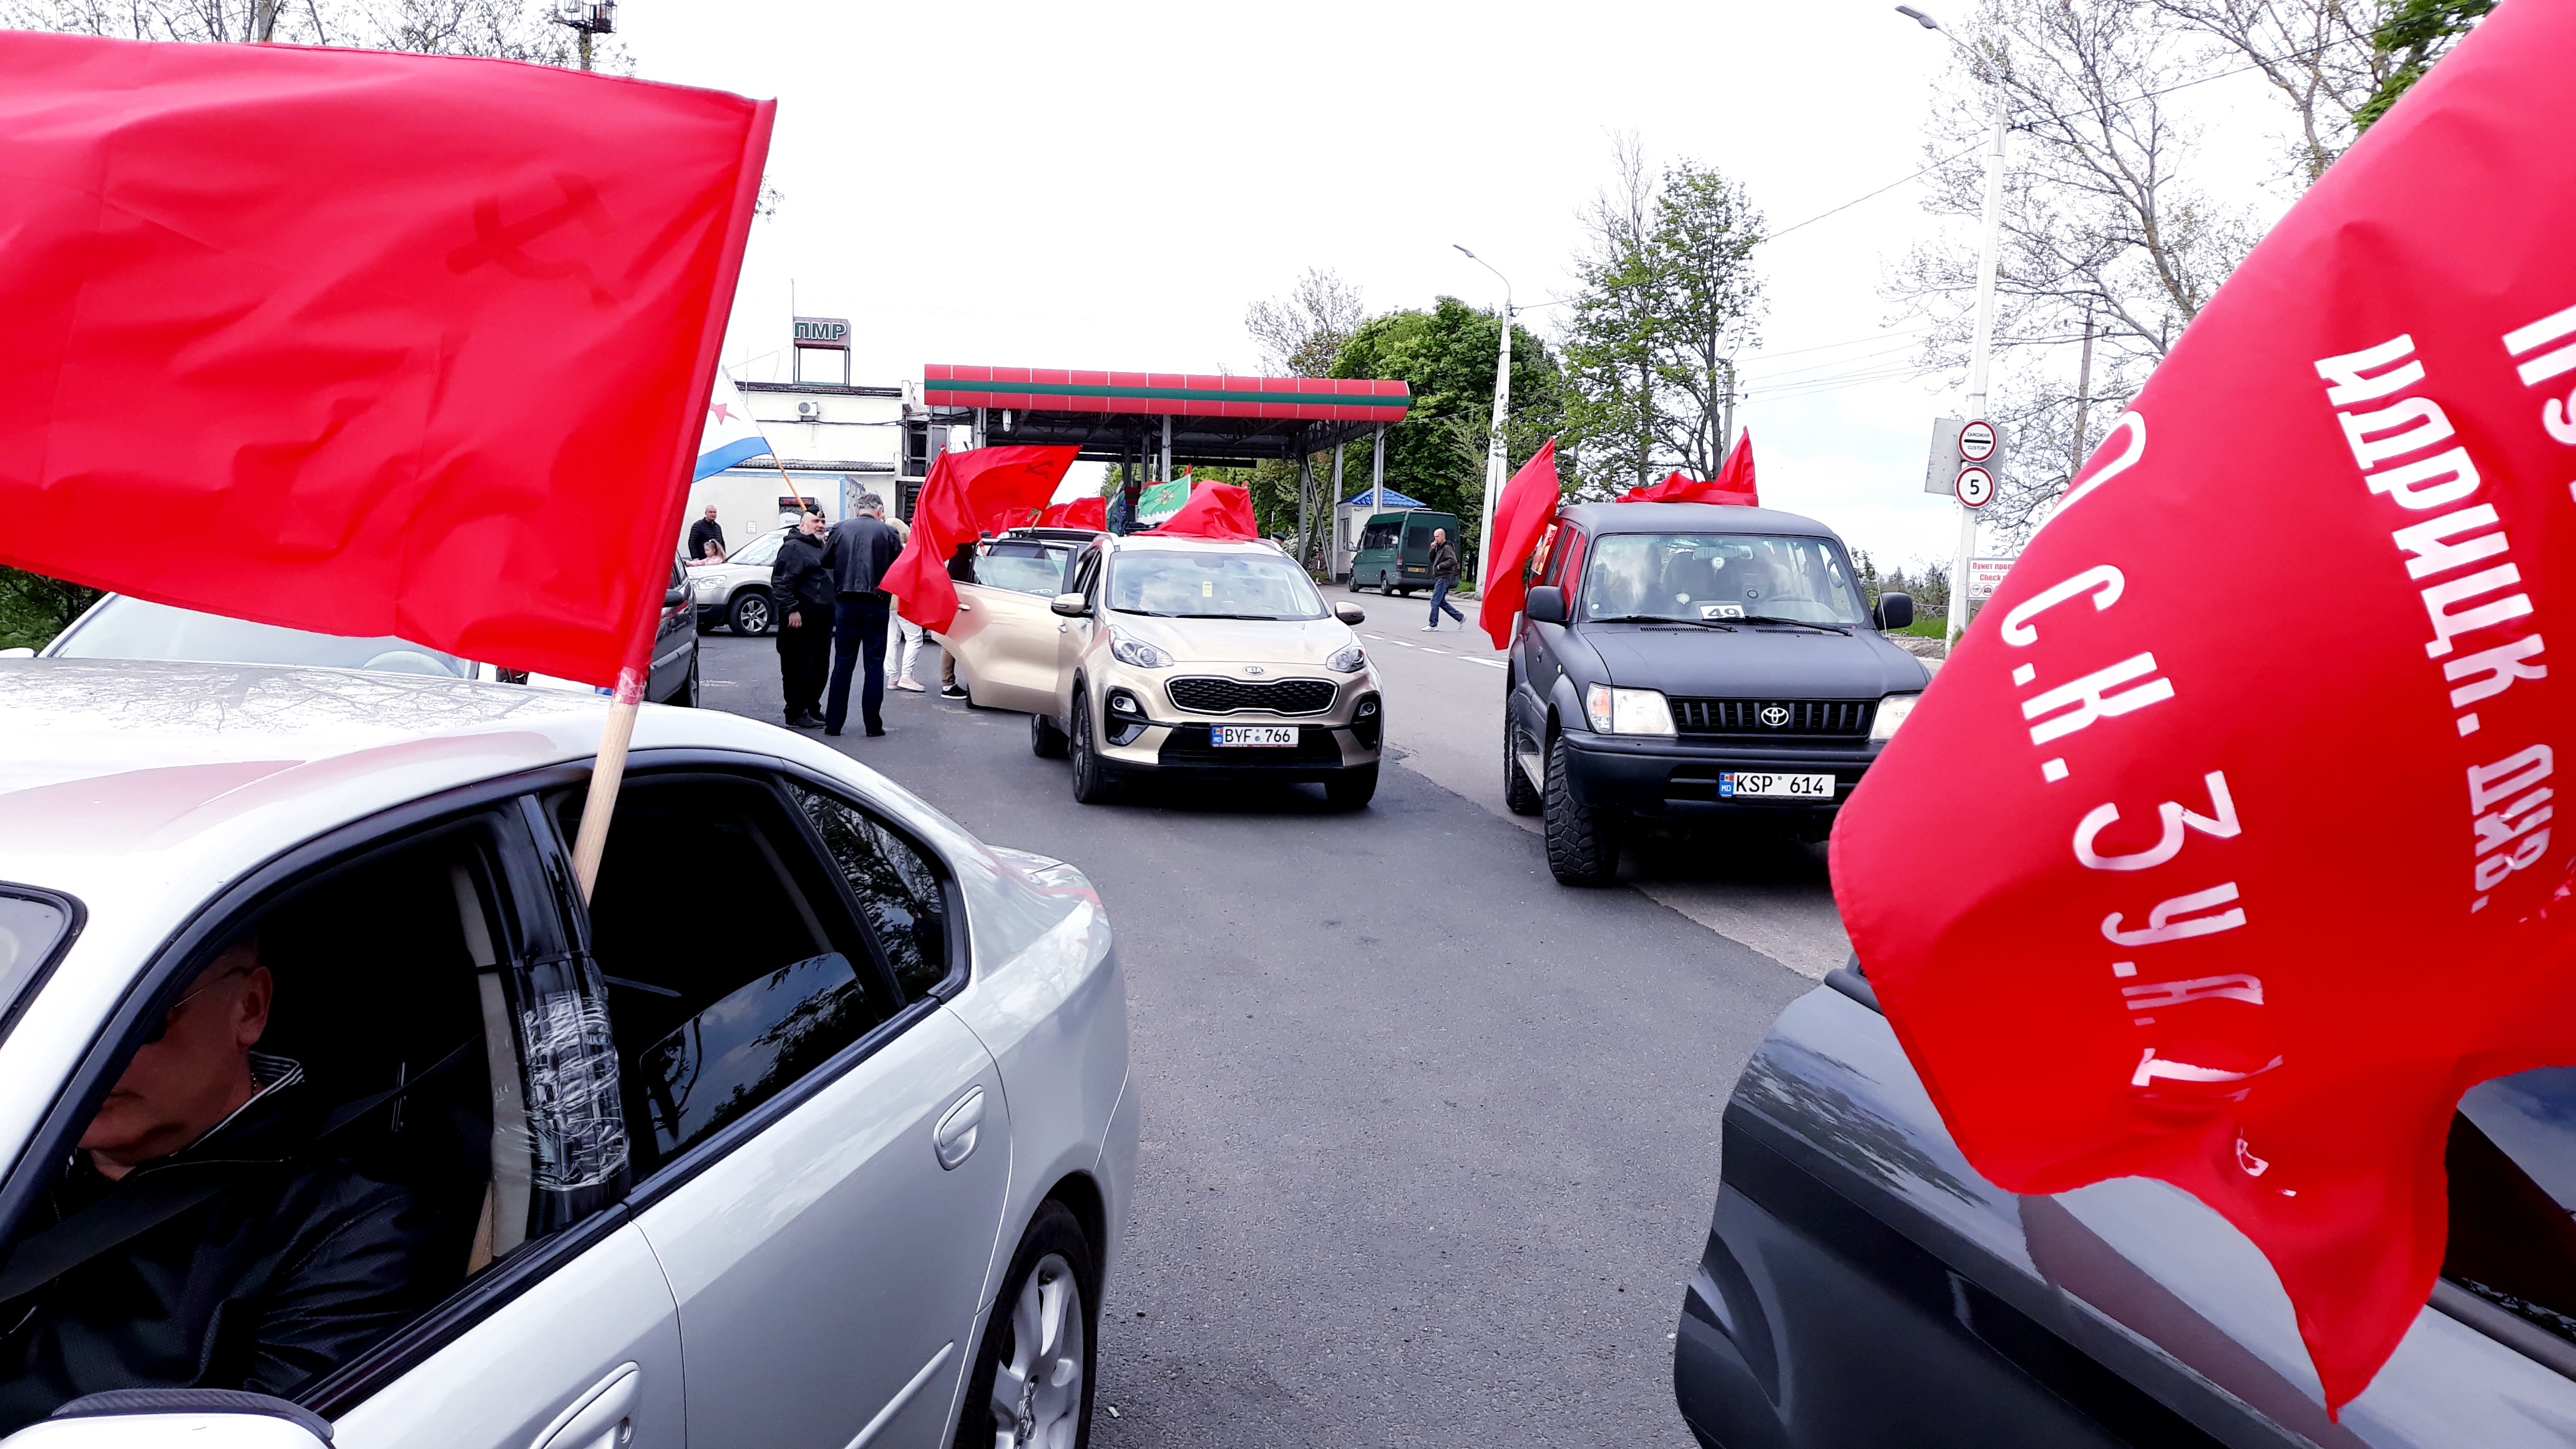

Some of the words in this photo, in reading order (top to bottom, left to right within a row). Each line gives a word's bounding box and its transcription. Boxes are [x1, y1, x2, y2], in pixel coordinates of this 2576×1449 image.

[794, 321, 847, 340] ПМР
[1969, 479, 1979, 495] 5
[1707, 608, 1740, 618] 49
[1225, 729, 1252, 743] BYF
[1265, 729, 1290, 743] 766
[1736, 775, 1772, 793] KSP
[1790, 776, 1824, 794] 614
